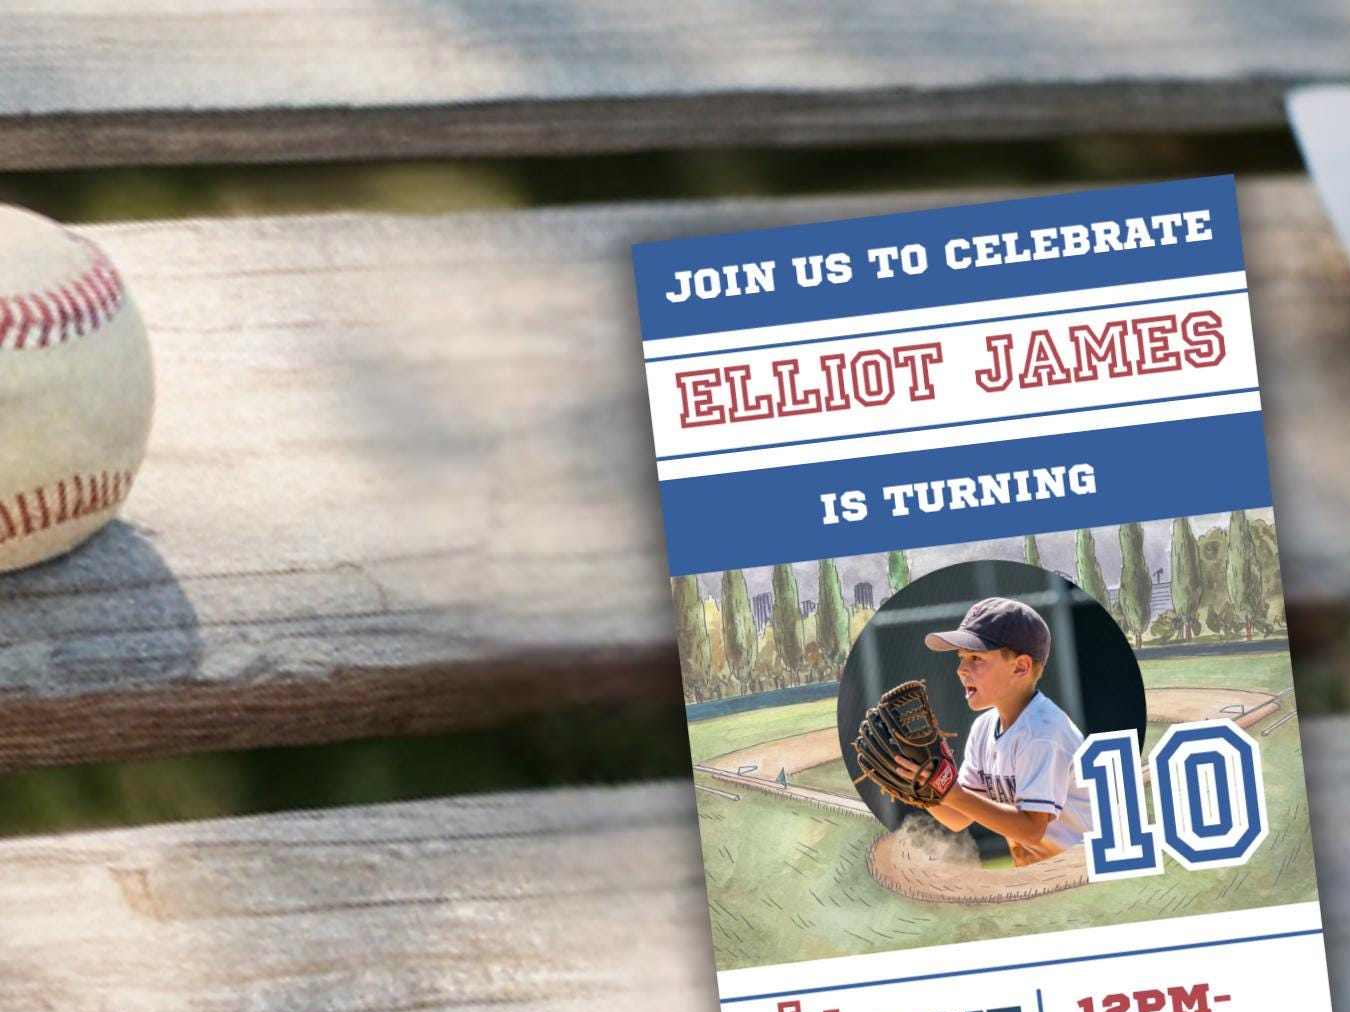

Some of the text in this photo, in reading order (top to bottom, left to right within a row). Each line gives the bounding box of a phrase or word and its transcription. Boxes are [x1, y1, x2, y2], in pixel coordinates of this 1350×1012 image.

[666, 210, 1212, 302] JOIN US TO CELEBRATE
[675, 310, 1226, 429] ELLIOT JAMES
[820, 463, 1097, 525] IS TURNING
[1074, 719, 1269, 882] 10
